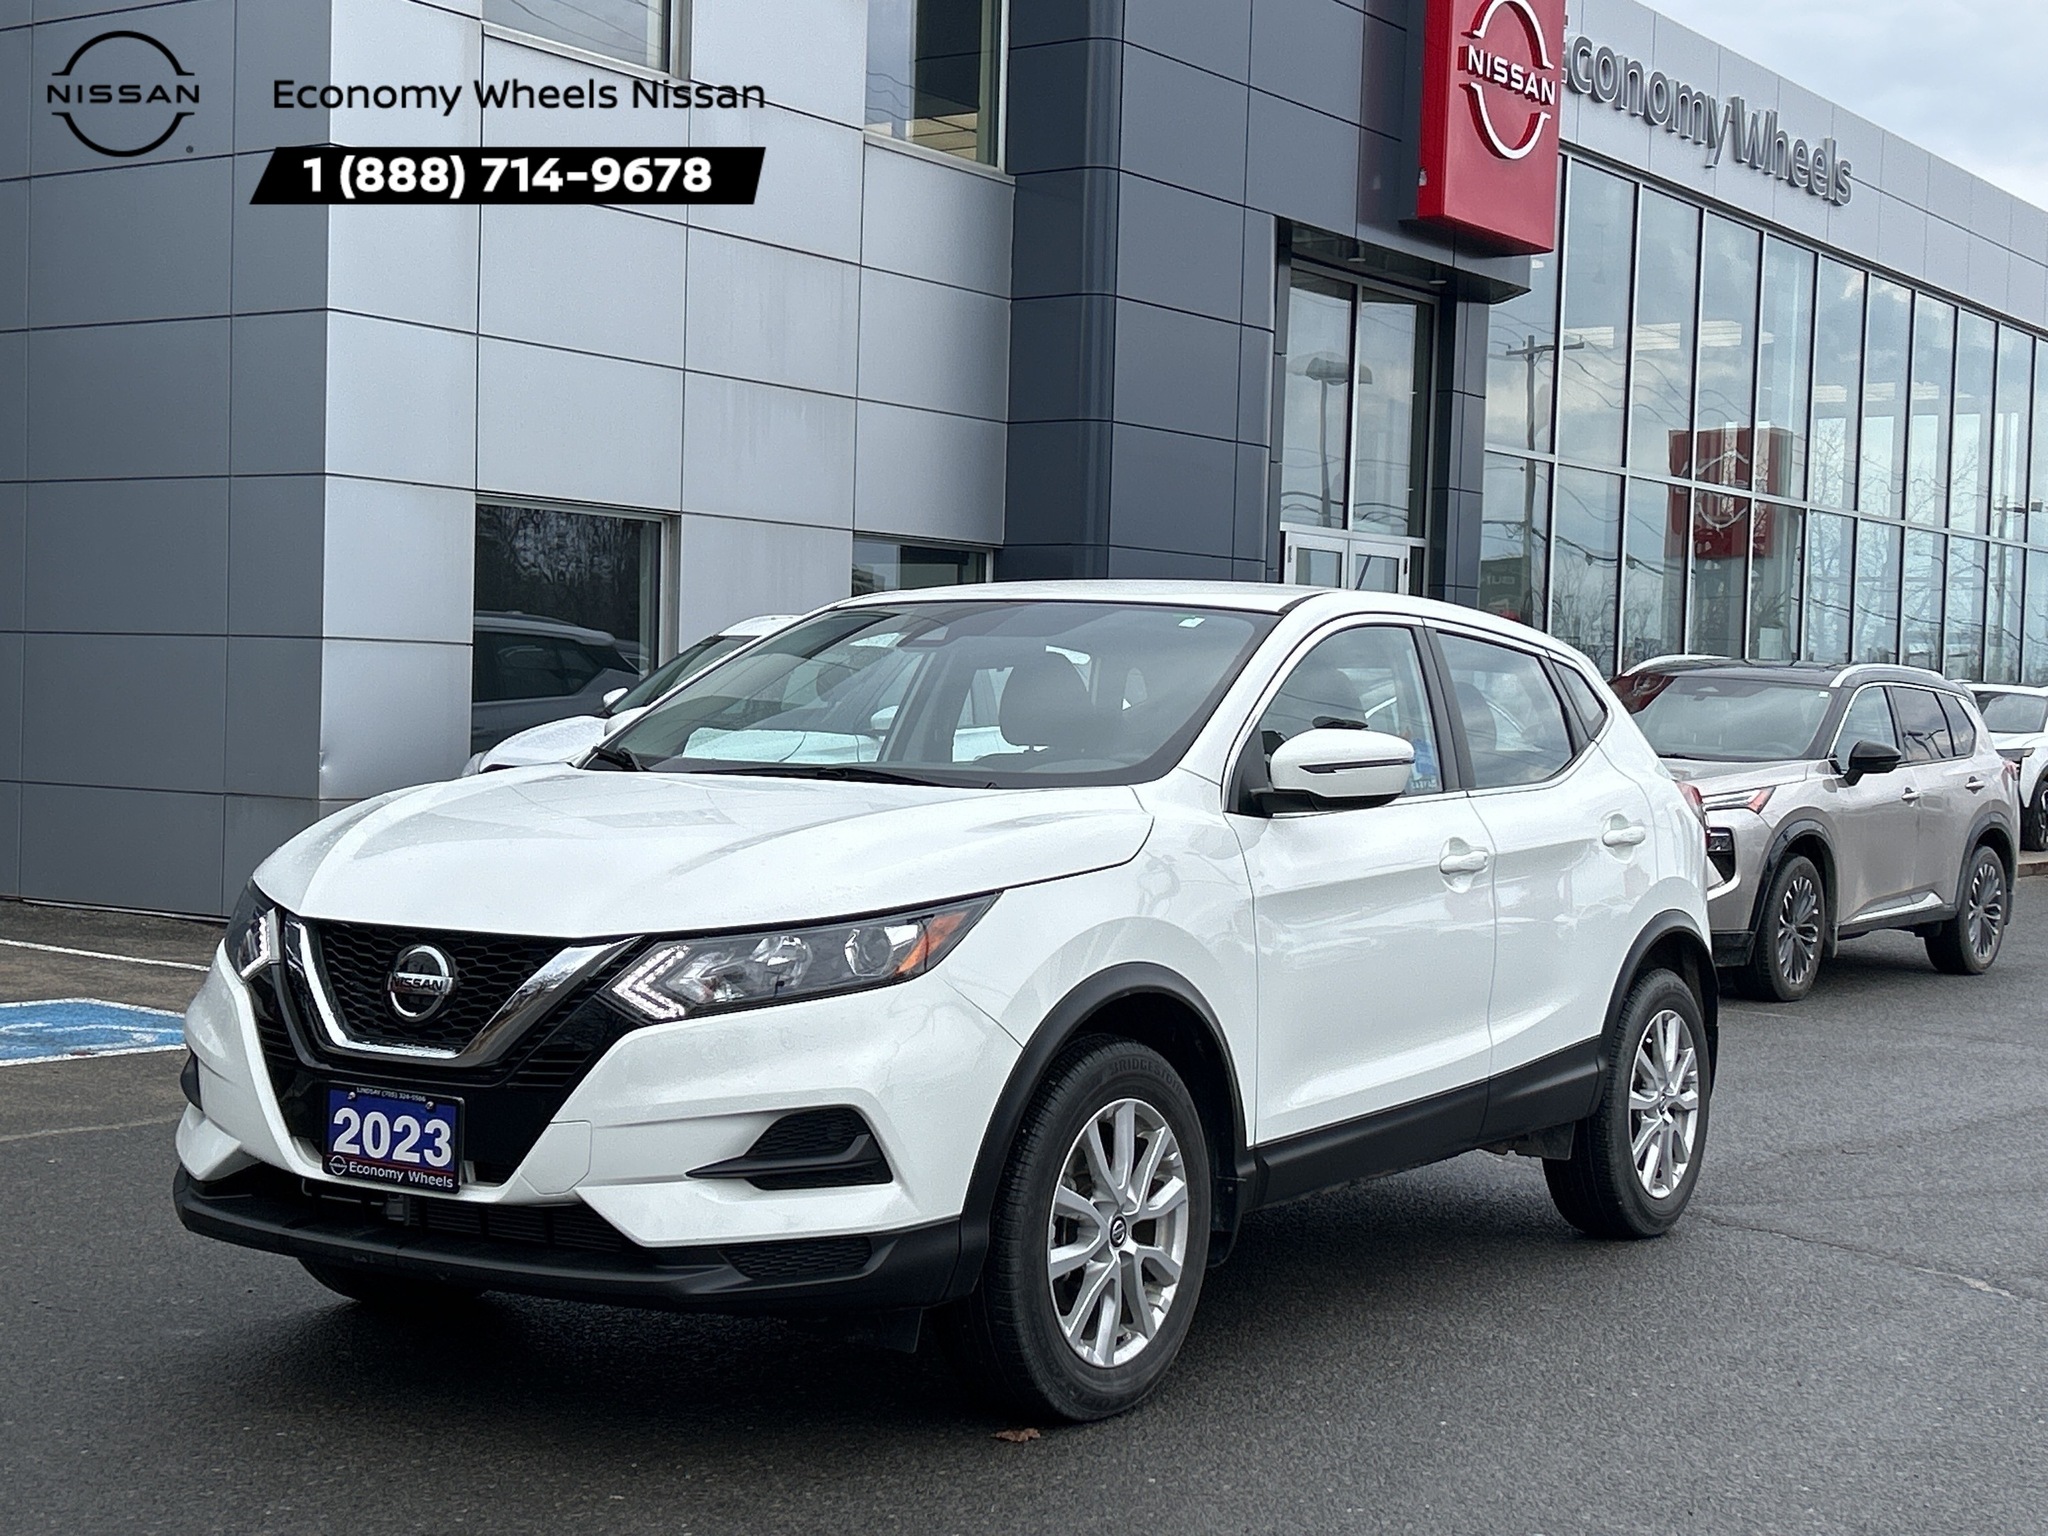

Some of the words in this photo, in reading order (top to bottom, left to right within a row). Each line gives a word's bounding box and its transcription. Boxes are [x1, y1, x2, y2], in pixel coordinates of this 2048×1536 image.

[1467, 44, 1556, 106] NISSAN
[1561, 14, 1732, 169] conomy
[1730, 97, 1853, 206] Wheels
[392, 975, 444, 992] NISSAN
[333, 1107, 452, 1167] 2023
[349, 1161, 404, 1182] Economy
[408, 1170, 453, 1188] Wheels
